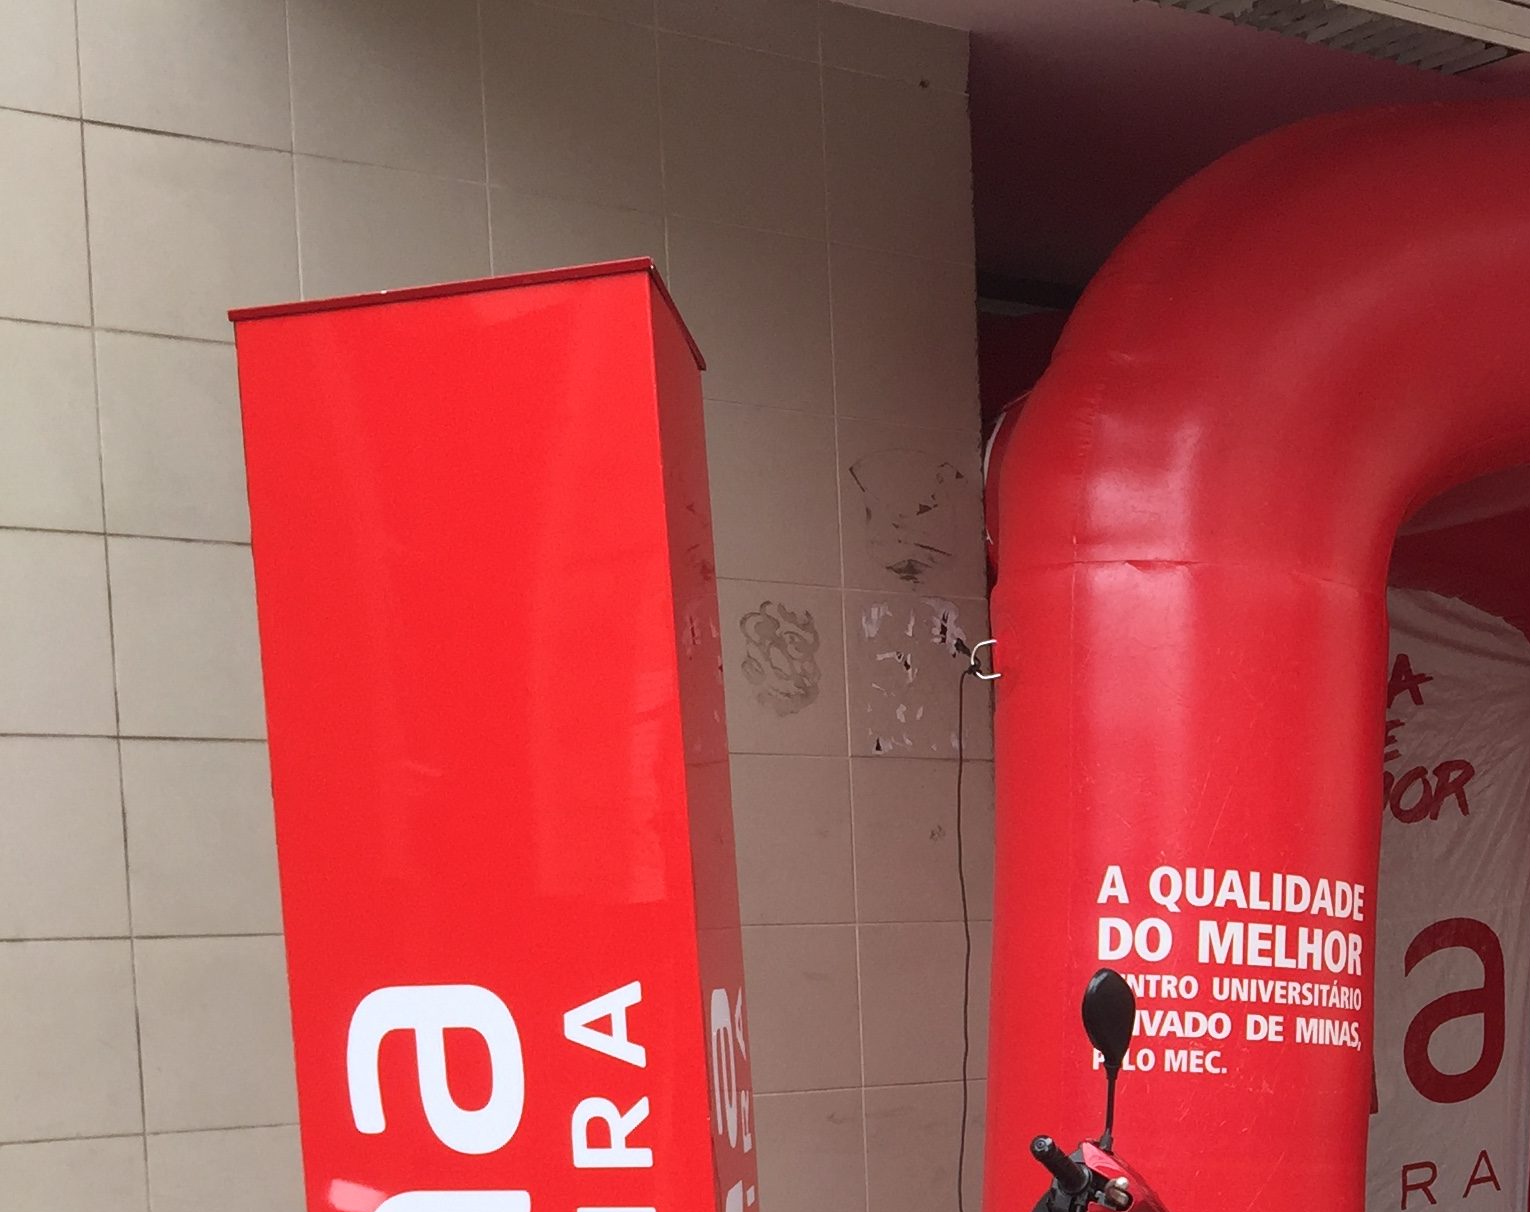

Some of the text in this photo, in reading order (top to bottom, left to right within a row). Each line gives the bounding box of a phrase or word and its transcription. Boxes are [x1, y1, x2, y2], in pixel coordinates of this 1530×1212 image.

[1097, 865, 1365, 922] A QUALIDADE
[1098, 917, 1362, 976] DO MELHOR
[1119, 973, 1362, 1011] NTRO UNIVERSITÁRIO
[1131, 1010, 1362, 1051] IVADO DE MINAS,
[1092, 1048, 1228, 1074] PLO MEC.
